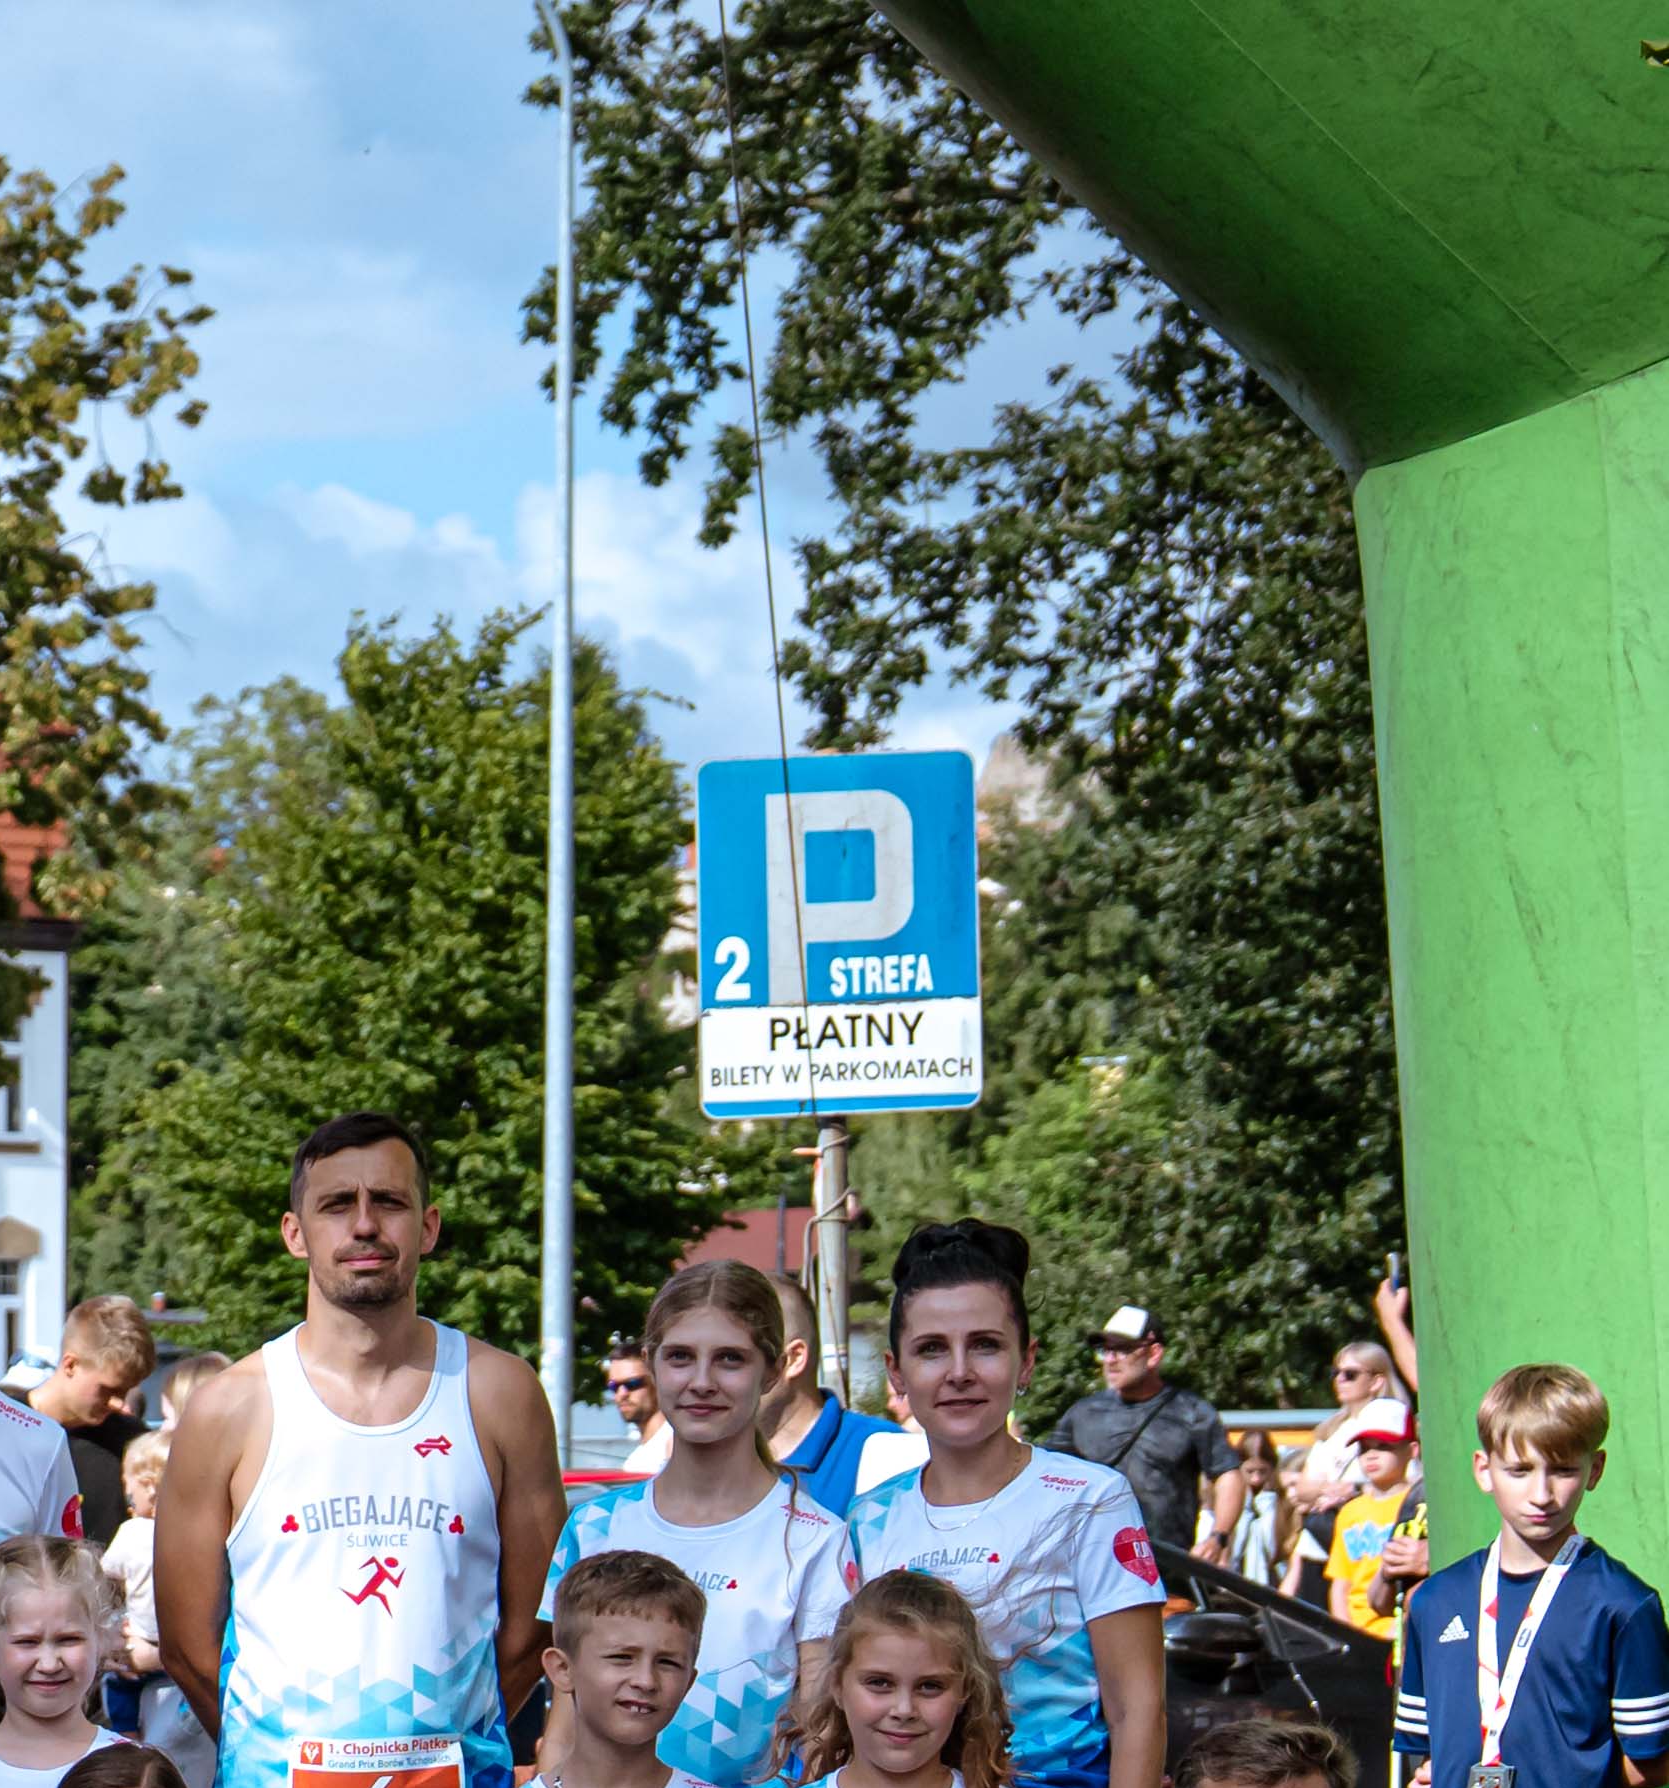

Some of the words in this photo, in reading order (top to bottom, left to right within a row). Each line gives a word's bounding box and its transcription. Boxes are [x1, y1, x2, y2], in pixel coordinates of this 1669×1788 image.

[765, 789, 915, 1005] P
[714, 936, 751, 1001] 2
[830, 954, 934, 997] STREFA
[769, 1011, 924, 1051] PŁATNY
[711, 1065, 774, 1087] BILETY
[782, 1064, 801, 1084] W
[811, 1057, 973, 1082] PARKOMATACH
[302, 1495, 449, 1534] BIEGAJĄCE
[328, 1759, 355, 1769] Grand
[358, 1760, 375, 1769] Prix
[329, 1743, 340, 1754] 1.
[343, 1742, 408, 1757] Chojnicka
[412, 1738, 448, 1753] Piątka
